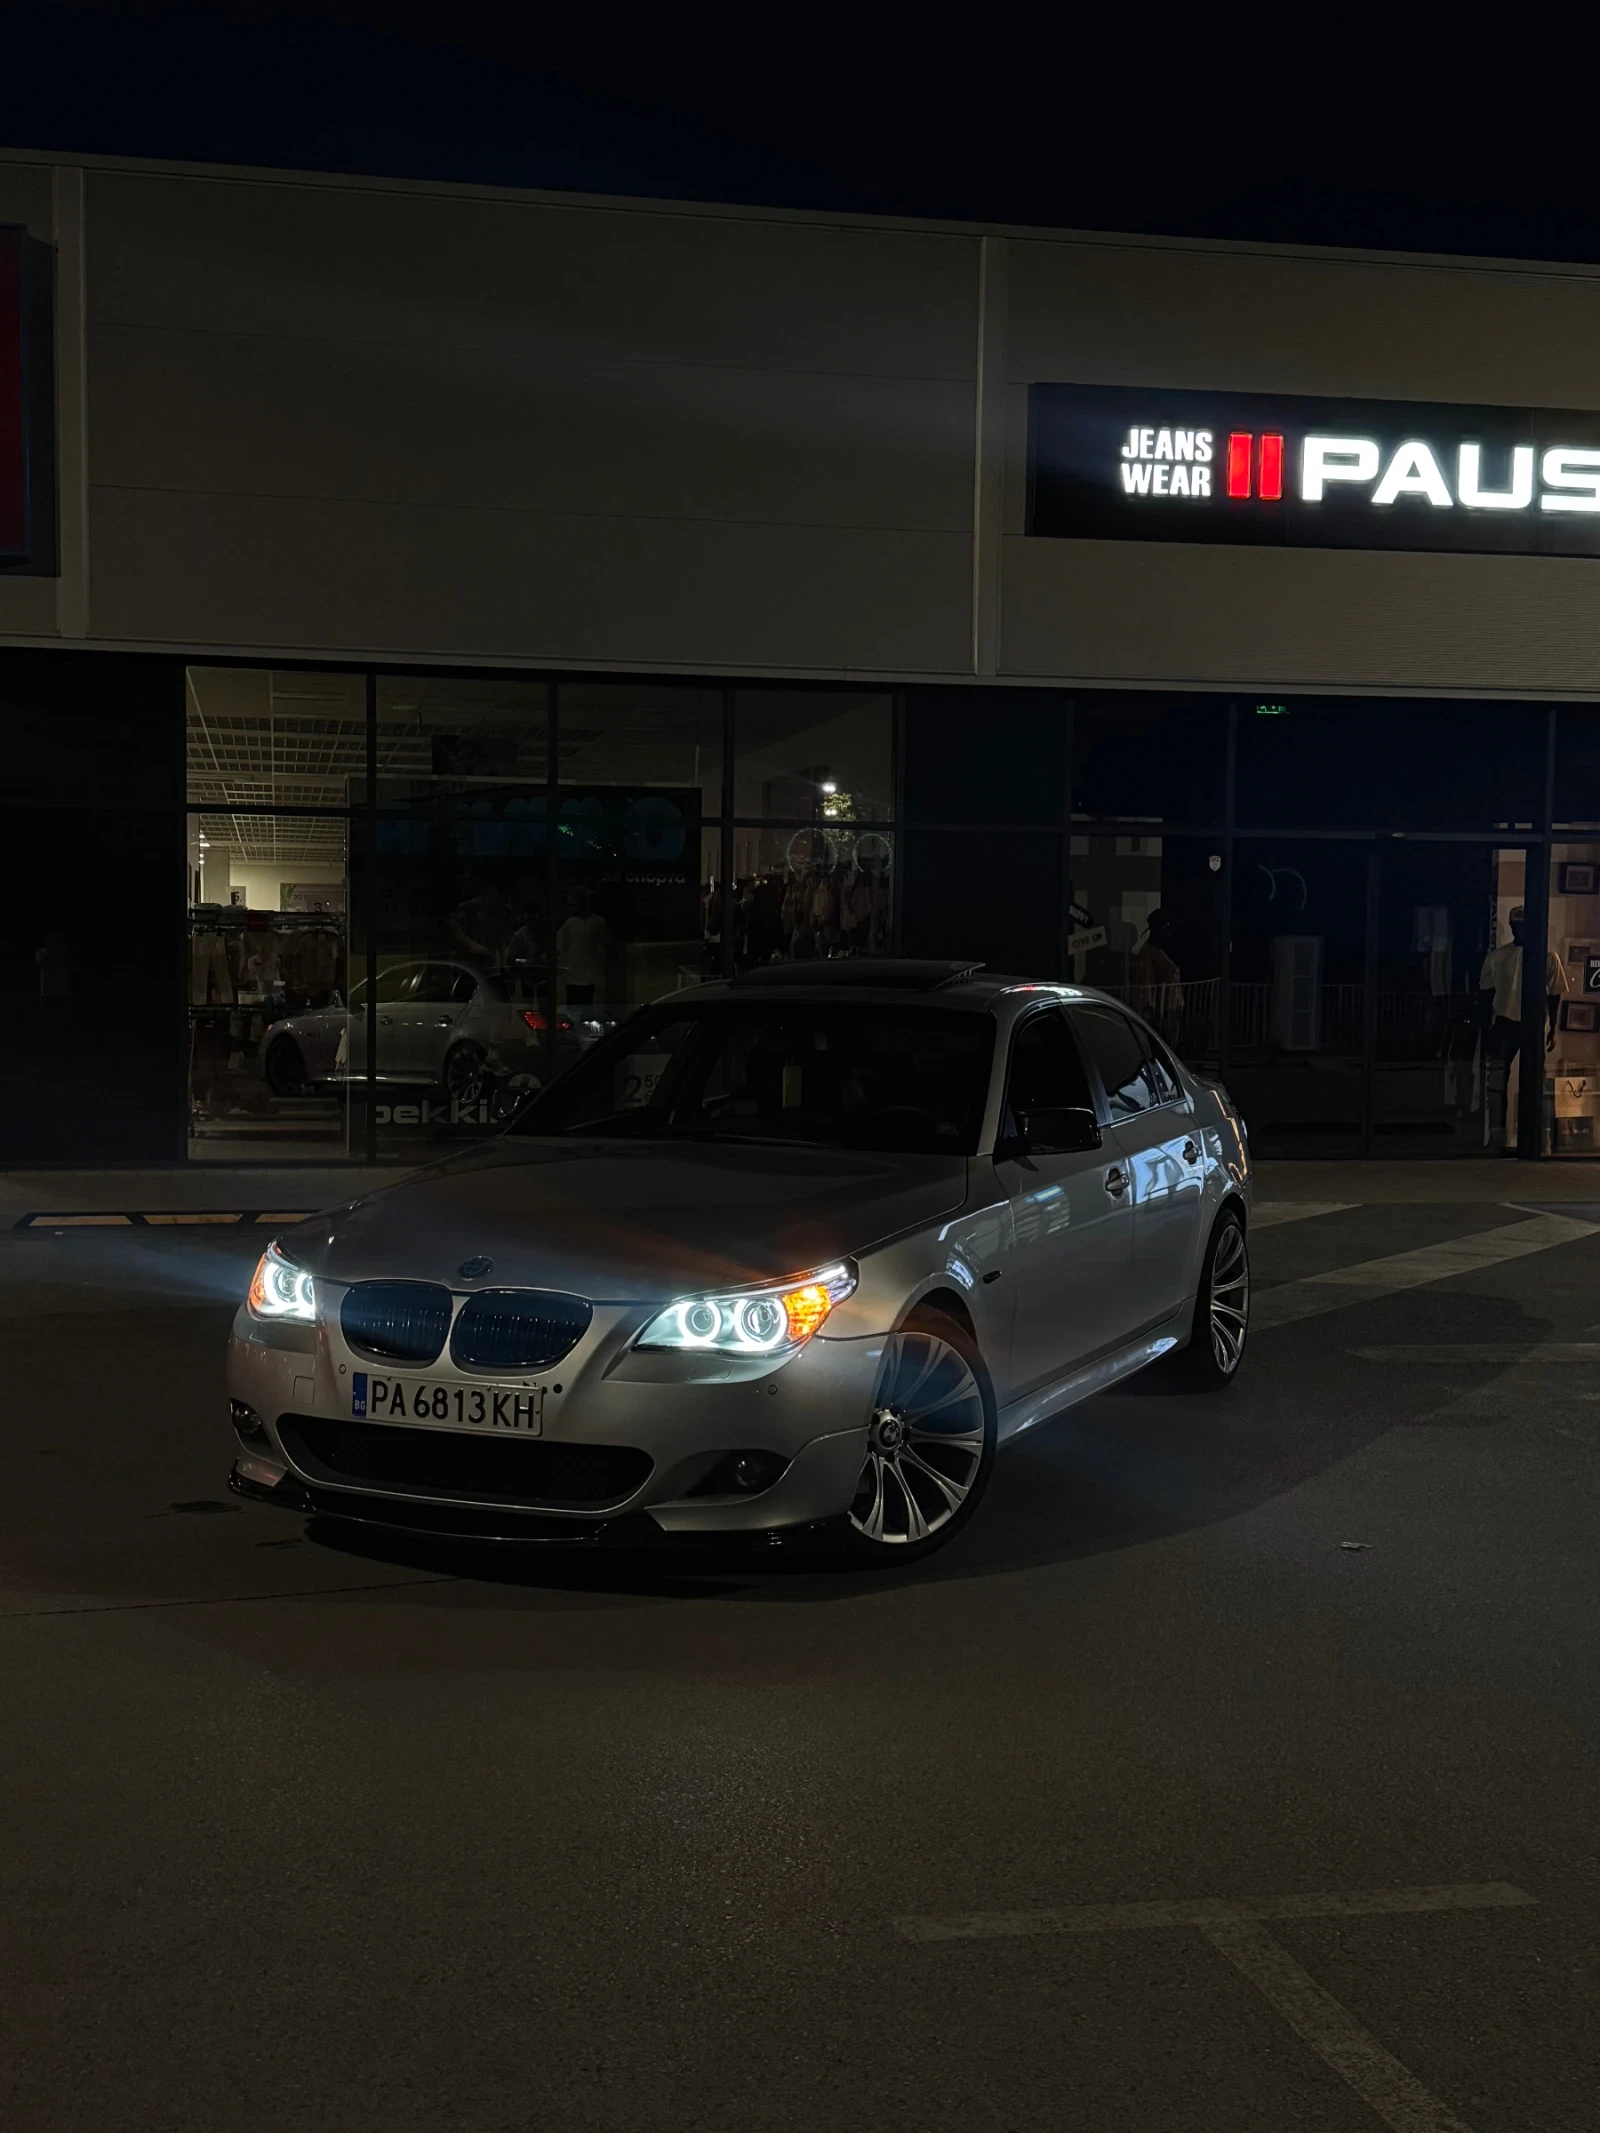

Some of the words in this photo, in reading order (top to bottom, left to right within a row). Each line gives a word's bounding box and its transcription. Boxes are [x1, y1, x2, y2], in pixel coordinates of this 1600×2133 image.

[1121, 428, 1213, 462] JEANS
[1120, 463, 1211, 497] WEAR
[1301, 435, 1600, 512] PAUS
[354, 1400, 366, 1411] BG
[371, 1380, 535, 1429] PA6813KH
